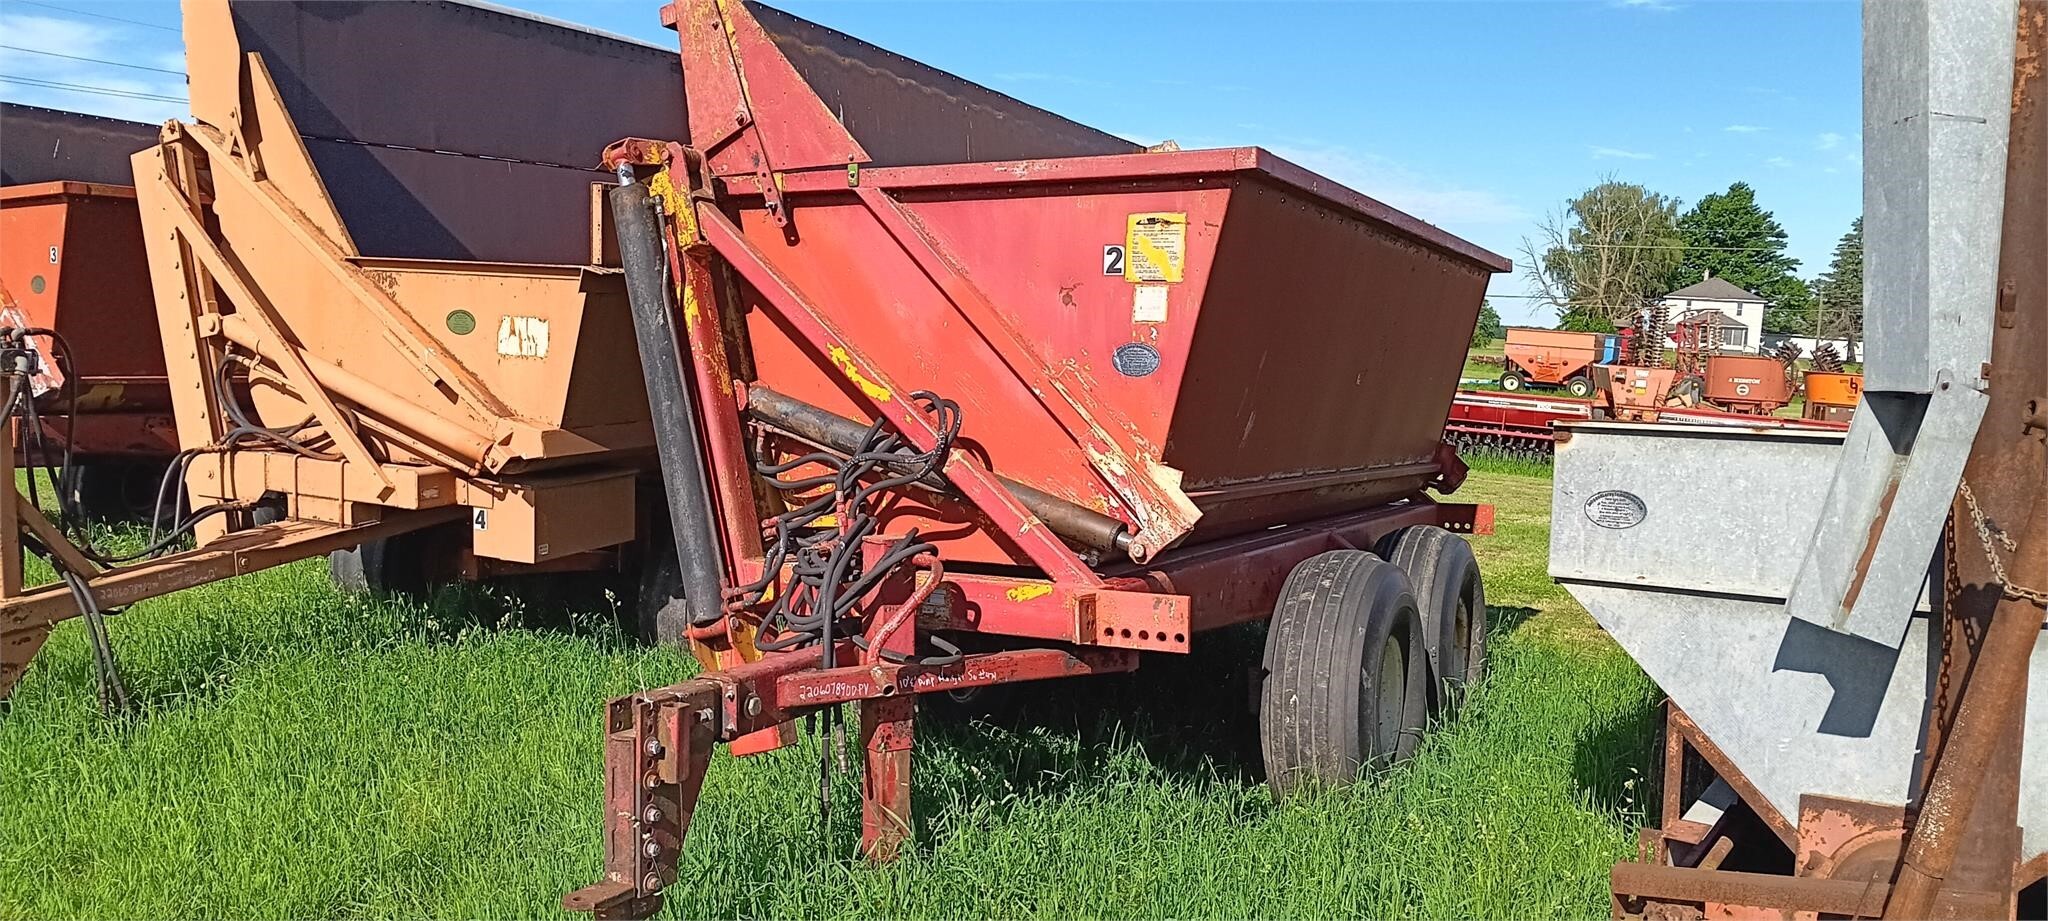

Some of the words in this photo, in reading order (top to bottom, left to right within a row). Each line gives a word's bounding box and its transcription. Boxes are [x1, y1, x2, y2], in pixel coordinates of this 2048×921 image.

[51, 247, 57, 262] 3
[1105, 246, 1123, 274] 2
[475, 510, 486, 529] 4
